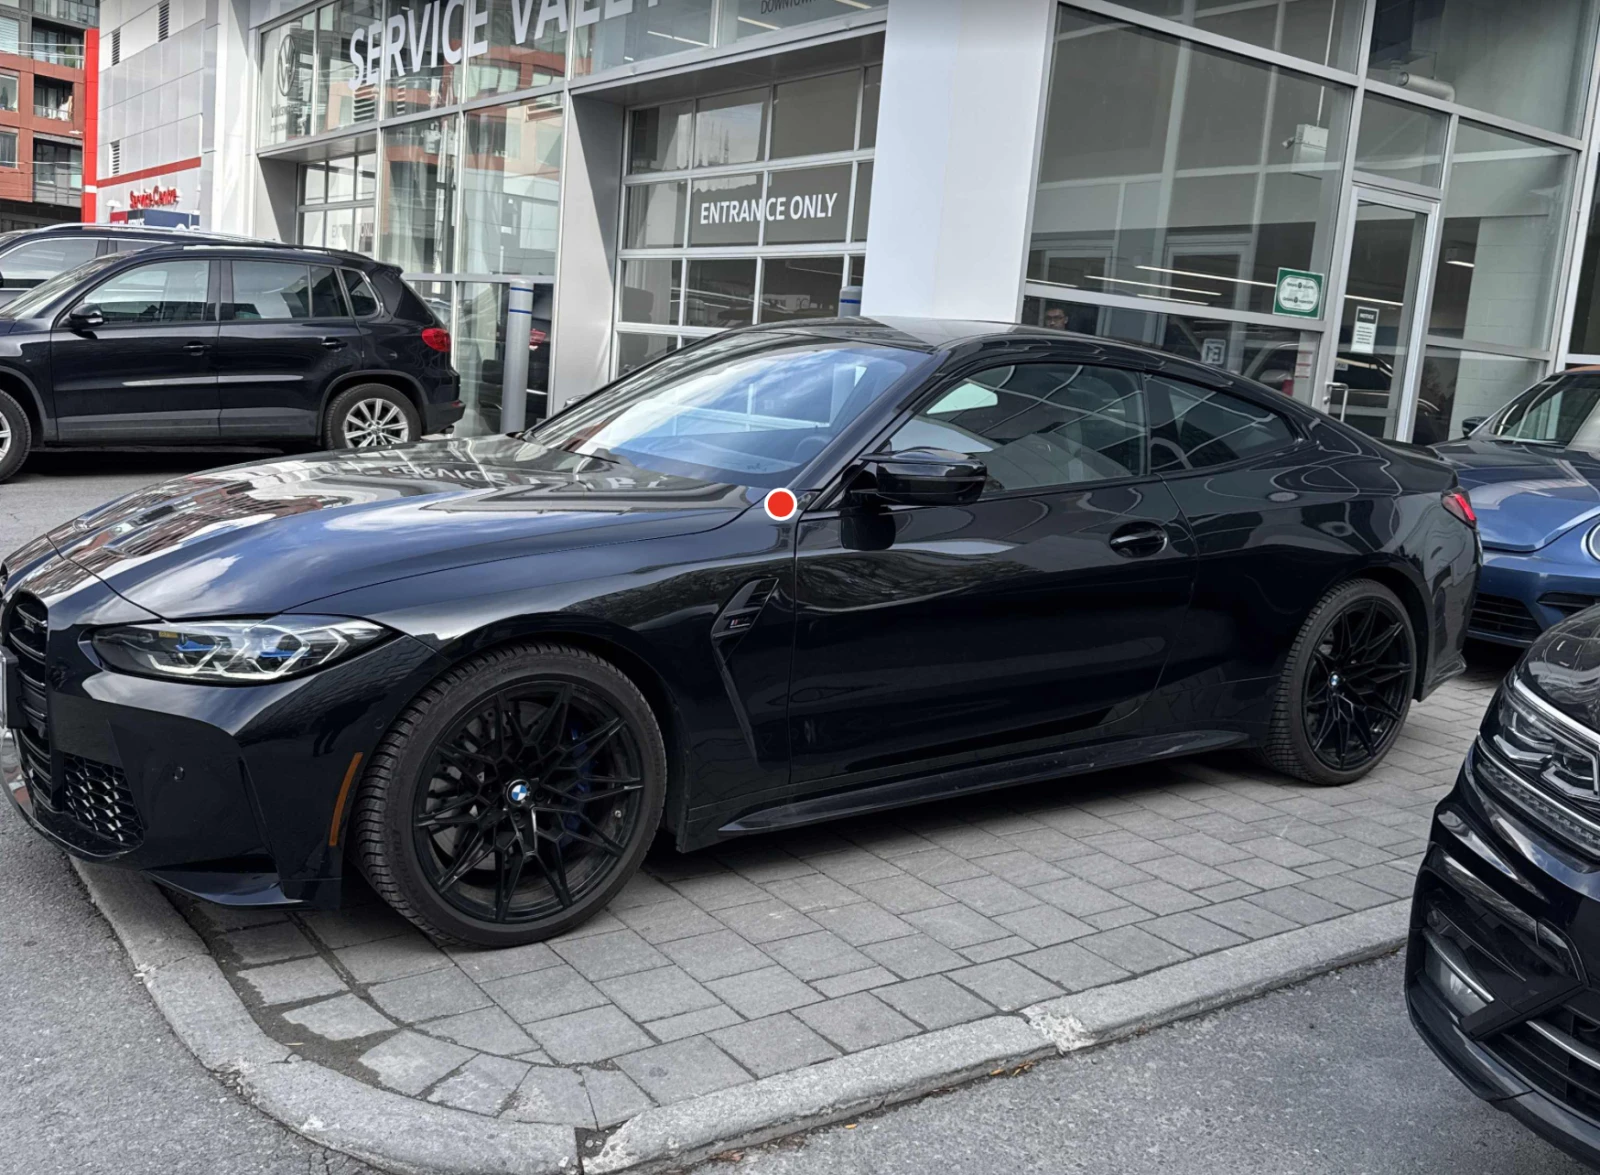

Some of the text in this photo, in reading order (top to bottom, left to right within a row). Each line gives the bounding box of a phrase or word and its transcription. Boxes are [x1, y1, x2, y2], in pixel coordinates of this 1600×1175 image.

[761, 0, 816, 14] DOWNT
[348, 0, 488, 91] SERVICE
[700, 192, 838, 225] ENTRANCE ONLY
[360, 222, 374, 237] ONL
